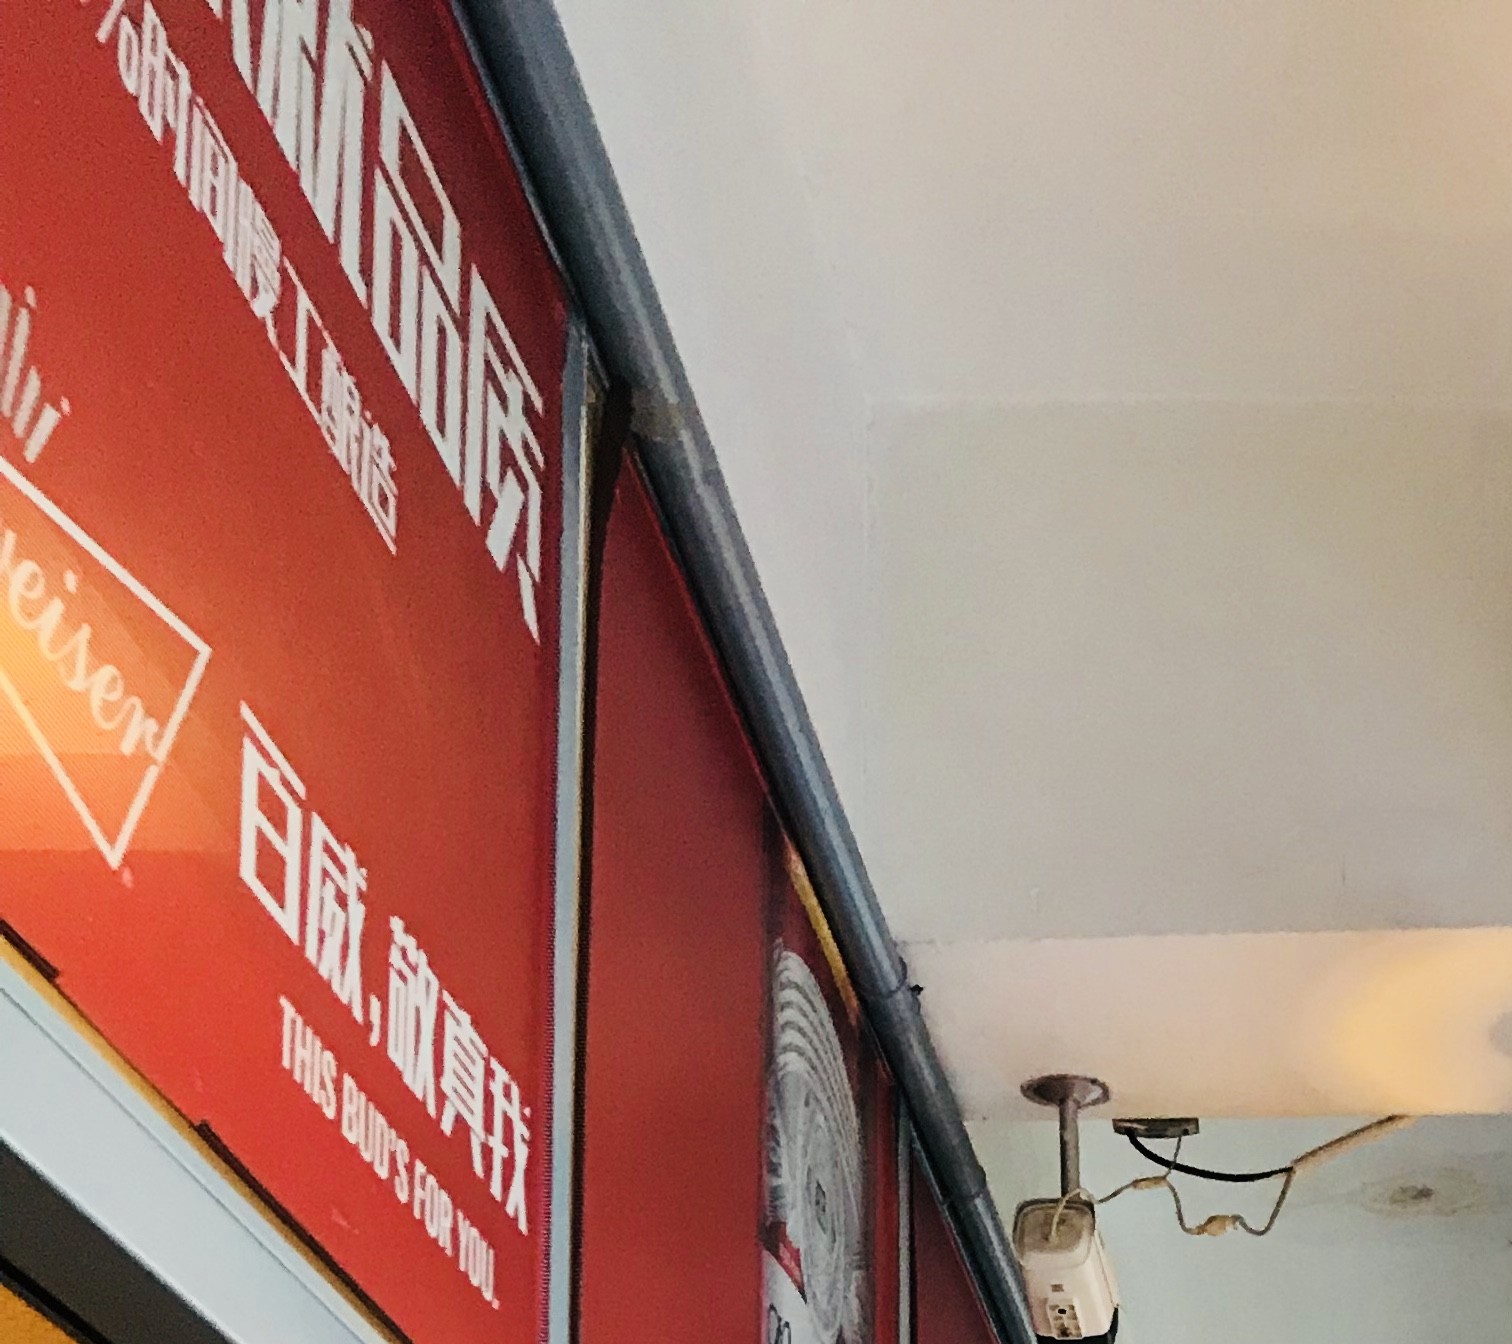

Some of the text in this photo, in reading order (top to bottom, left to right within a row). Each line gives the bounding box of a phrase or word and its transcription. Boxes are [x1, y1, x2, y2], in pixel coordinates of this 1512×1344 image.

[206, 0, 546, 646] 就品质
[0, 527, 166, 766] eiser
[279, 995, 501, 1310] THIS BUD'S FOR YOU.
